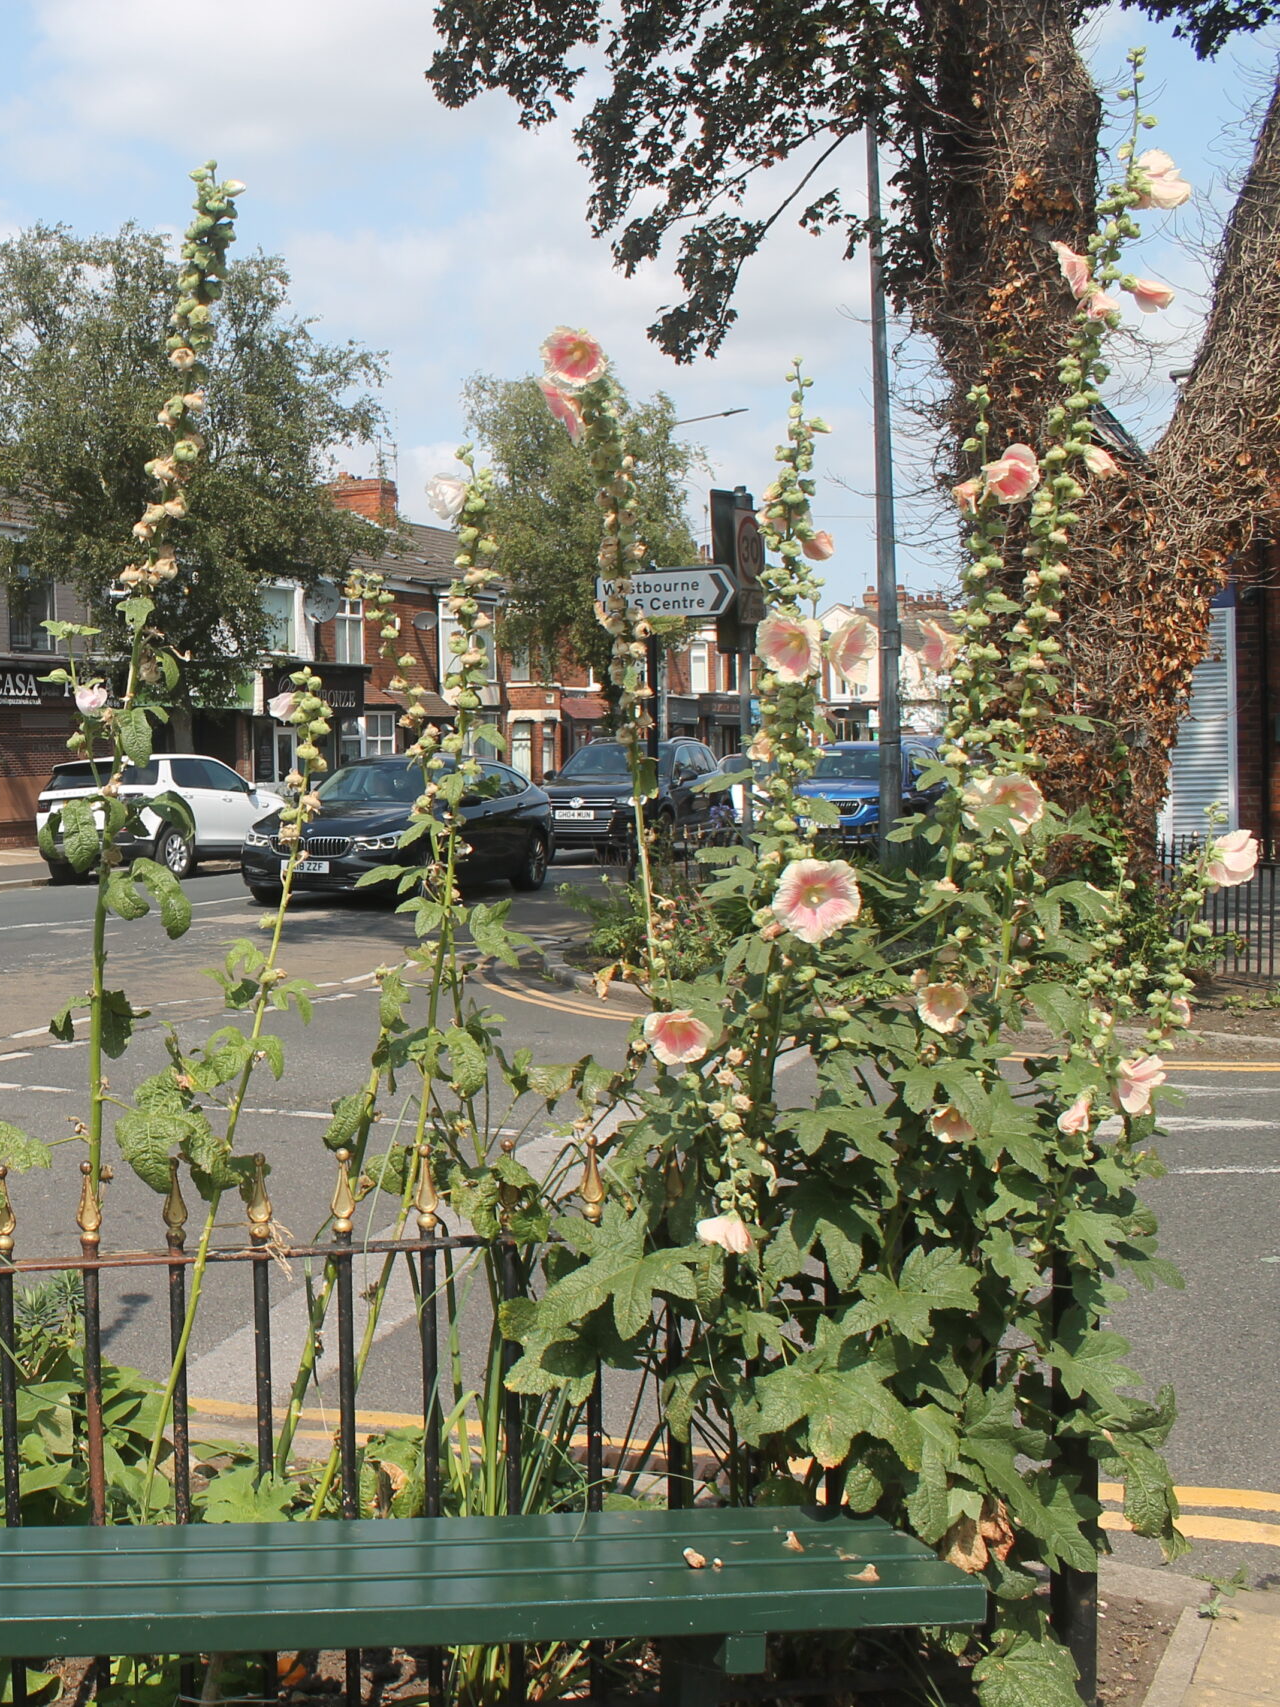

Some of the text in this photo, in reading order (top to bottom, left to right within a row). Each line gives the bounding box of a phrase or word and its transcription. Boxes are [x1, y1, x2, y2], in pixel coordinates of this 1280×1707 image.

[742, 536, 759, 563] 30
[603, 581, 700, 596] Wstbourne
[650, 597, 705, 610] Centre
[306, 862, 323, 872] ZZF
